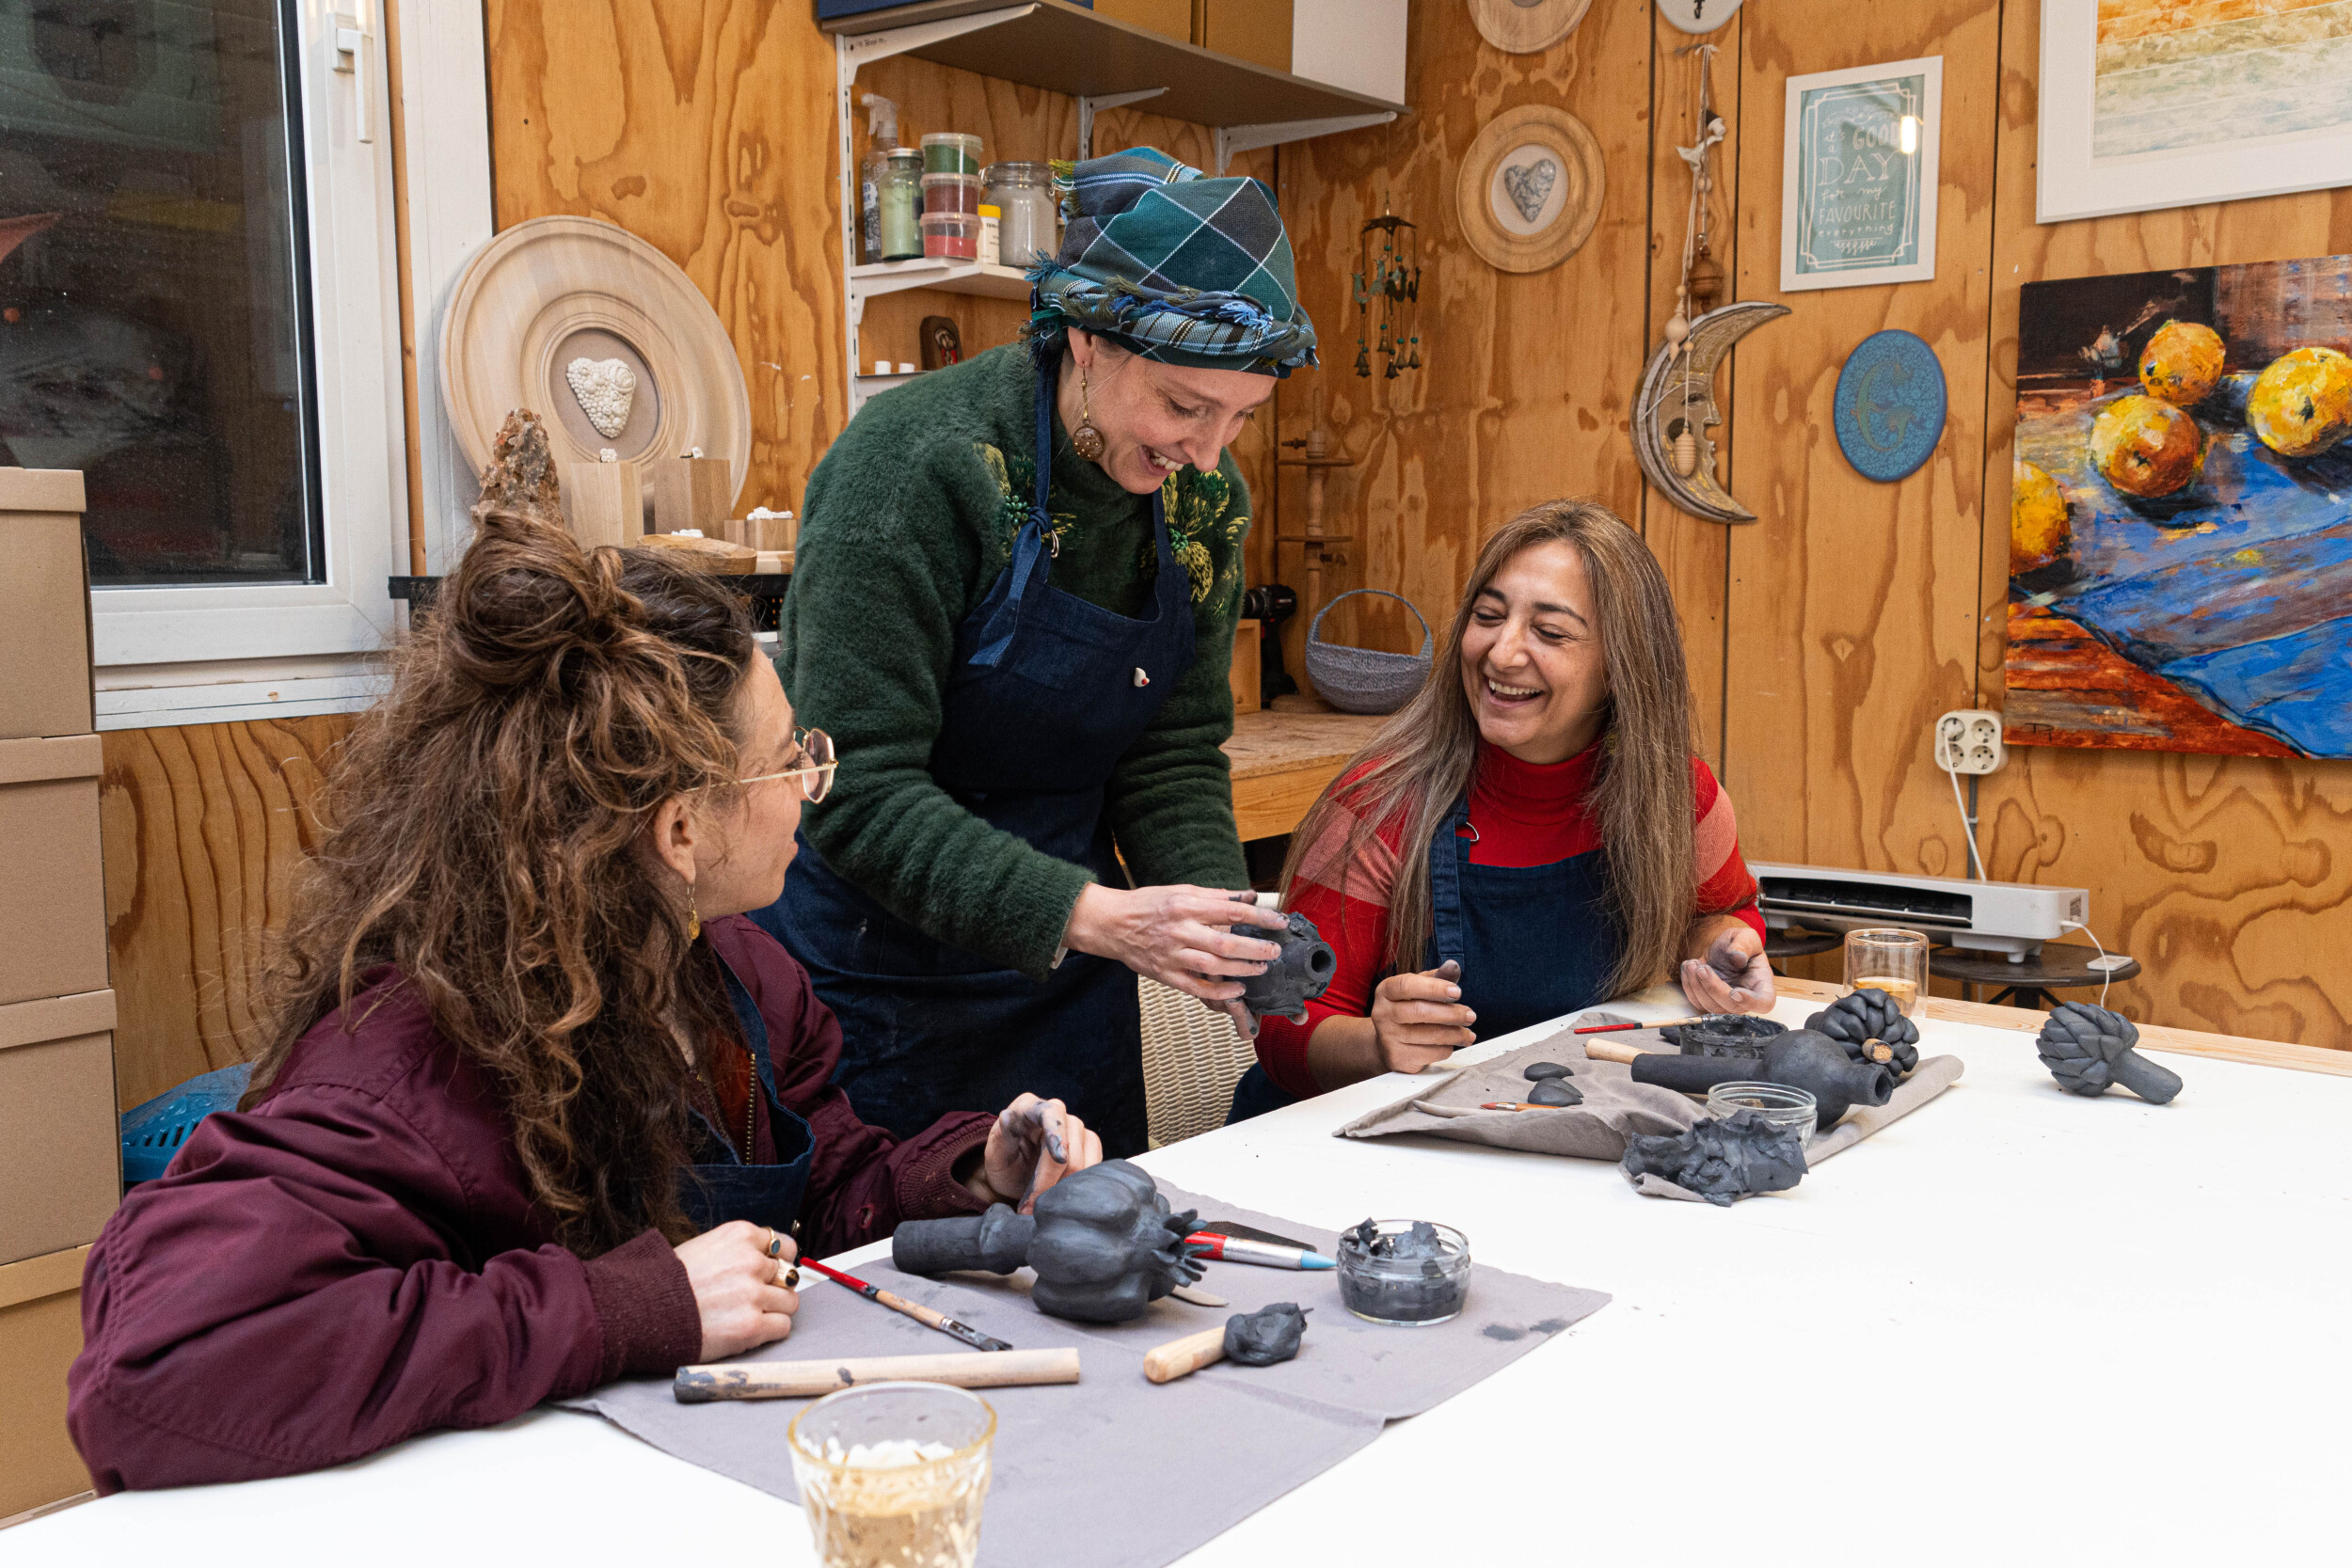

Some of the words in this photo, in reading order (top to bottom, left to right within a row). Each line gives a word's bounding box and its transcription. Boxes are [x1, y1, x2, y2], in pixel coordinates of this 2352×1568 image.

[1852, 122, 1900, 150] GOOD
[1828, 144, 1836, 153] a
[1818, 150, 1896, 186] DAY
[1821, 188, 1845, 205] for
[1856, 185, 1888, 200] my
[1819, 199, 1896, 225] FAVOURITE
[1818, 223, 1894, 237] everything
